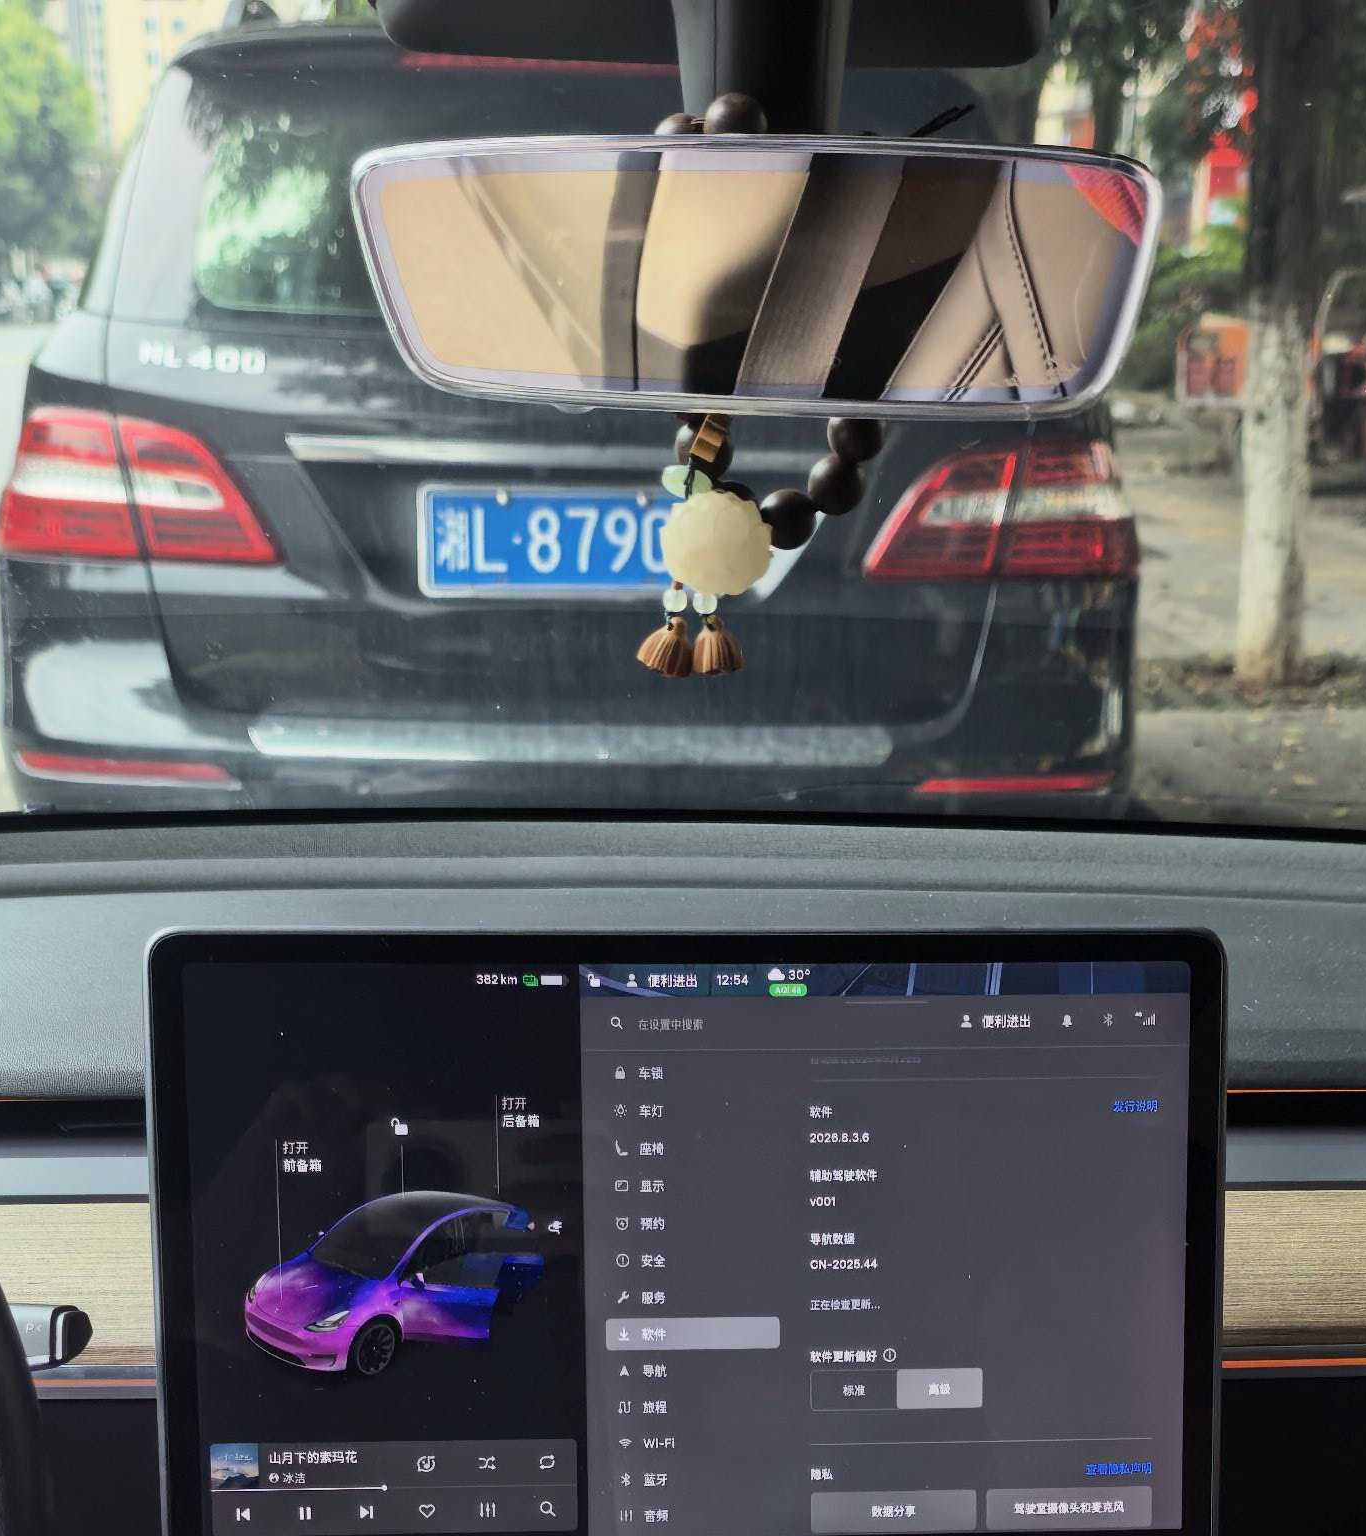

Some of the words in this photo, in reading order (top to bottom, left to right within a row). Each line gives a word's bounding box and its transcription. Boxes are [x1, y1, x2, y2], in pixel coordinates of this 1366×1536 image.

[476, 974, 499, 985] 382
[500, 973, 518, 985] km
[648, 974, 698, 988] 便利进出
[716, 974, 749, 986] 12:54
[788, 969, 811, 981] 30°
[638, 1018, 703, 1032] 在设置中搜索
[982, 1014, 1031, 1029] 便利进出
[638, 1066, 664, 1080] 车锁
[501, 1096, 527, 1111] 打开
[1113, 1099, 1158, 1113] 发行说明
[639, 1104, 664, 1118] 车灯
[809, 1105, 833, 1118] 软件
[502, 1114, 540, 1128] 后备箱
[283, 1141, 309, 1155] 打开
[639, 1142, 664, 1156] 座椅
[283, 1158, 322, 1173] 前备箱
[809, 1169, 878, 1182] 辅助驾驶软件
[639, 1180, 665, 1193] 显示
[809, 1196, 836, 1207] v001
[640, 1216, 666, 1231] 预约
[810, 1232, 855, 1246] 导航数据
[641, 1254, 666, 1268] 安全
[641, 1291, 666, 1305] 服务
[641, 1327, 667, 1342] 软件
[810, 1350, 878, 1363] 软件更新偏好
[642, 1364, 667, 1378] 导航
[842, 1384, 866, 1397] 标准
[928, 1383, 951, 1396] 高级
[642, 1400, 668, 1414] 旅程
[269, 1450, 357, 1465] 山月下的索玛花
[282, 1473, 306, 1484] 冰洁
[643, 1473, 668, 1487] 蓝牙
[810, 1468, 834, 1481] 隐私
[871, 1504, 917, 1518] 数据分享
[1013, 1501, 1125, 1515] 驾驶室摄像头和麦克风
[643, 1509, 669, 1523] 音频
